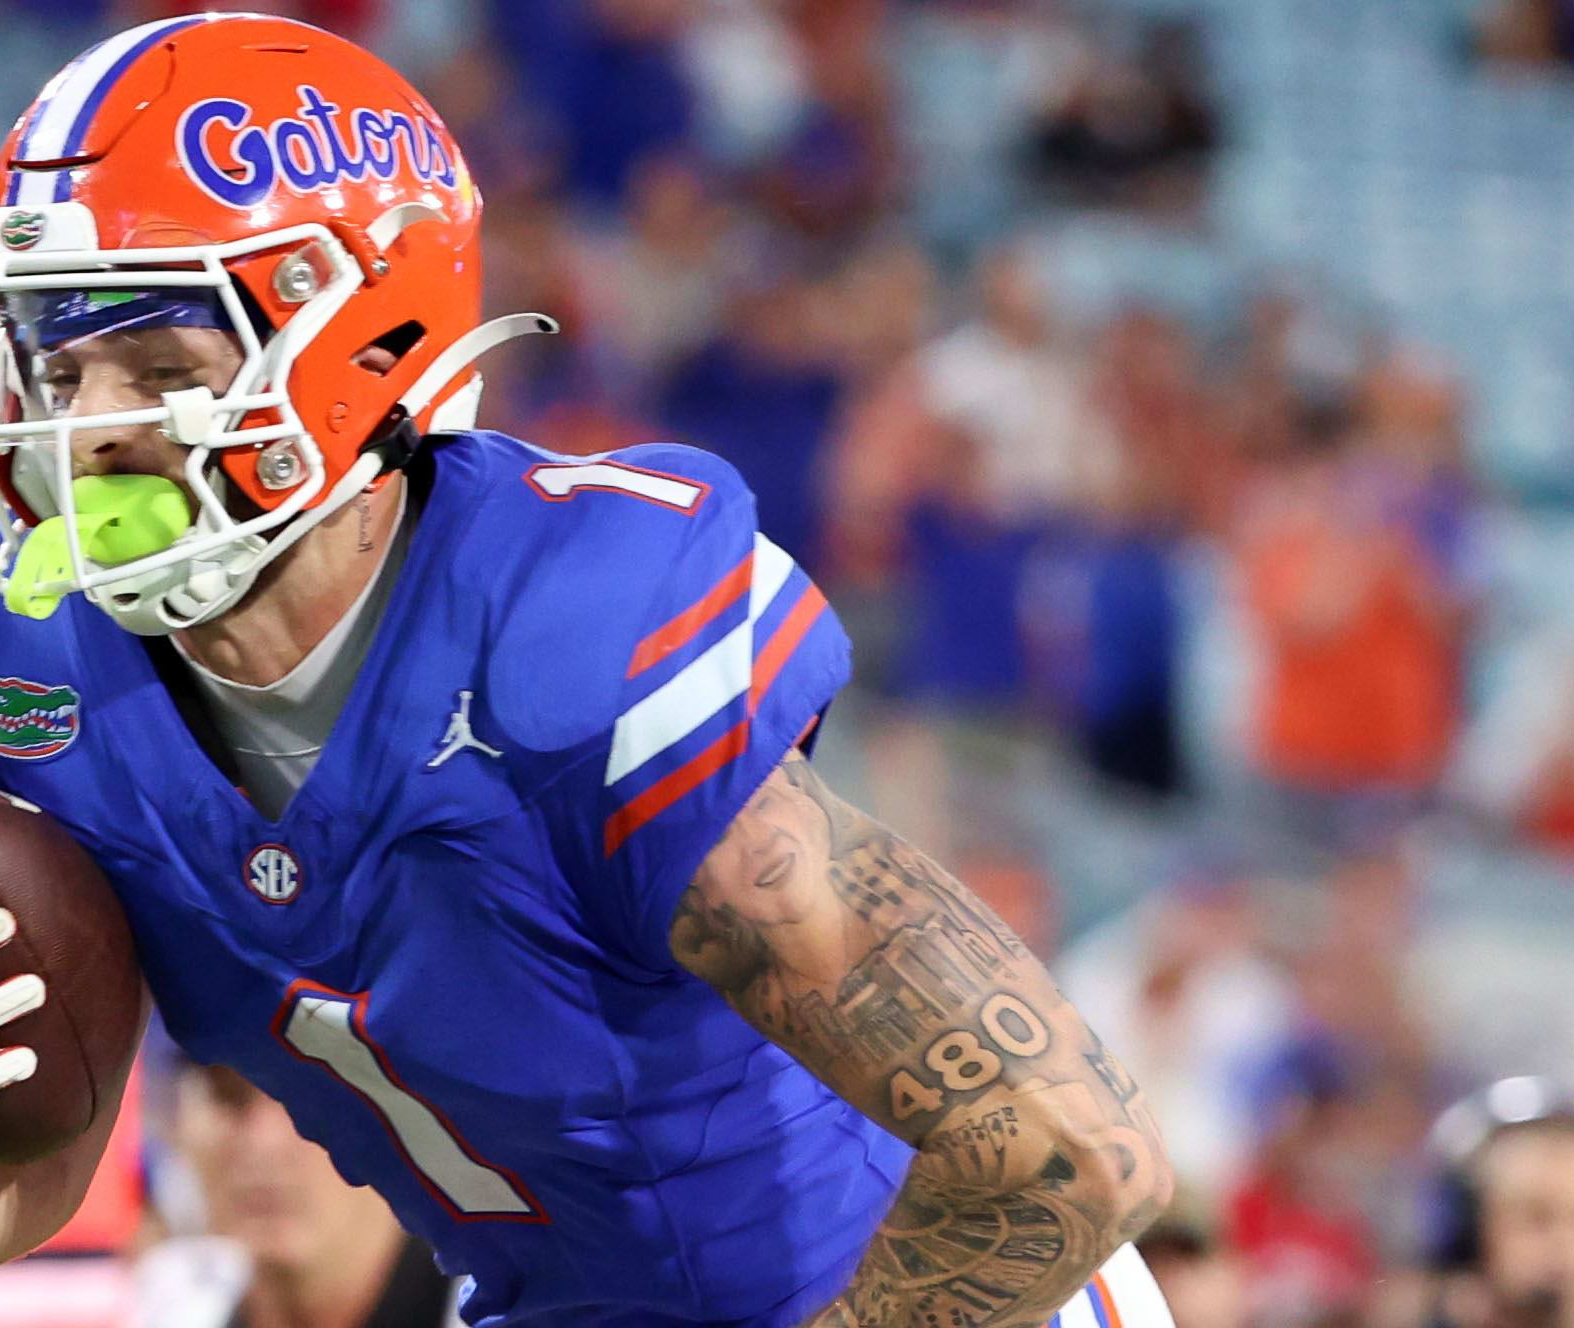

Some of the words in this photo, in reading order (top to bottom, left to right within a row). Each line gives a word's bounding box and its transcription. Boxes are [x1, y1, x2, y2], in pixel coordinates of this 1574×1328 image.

[176, 85, 457, 209] Gators
[523, 460, 712, 516] 1
[247, 845, 301, 902] SEC
[271, 978, 552, 1223] 1
[891, 991, 1050, 1121] 480
